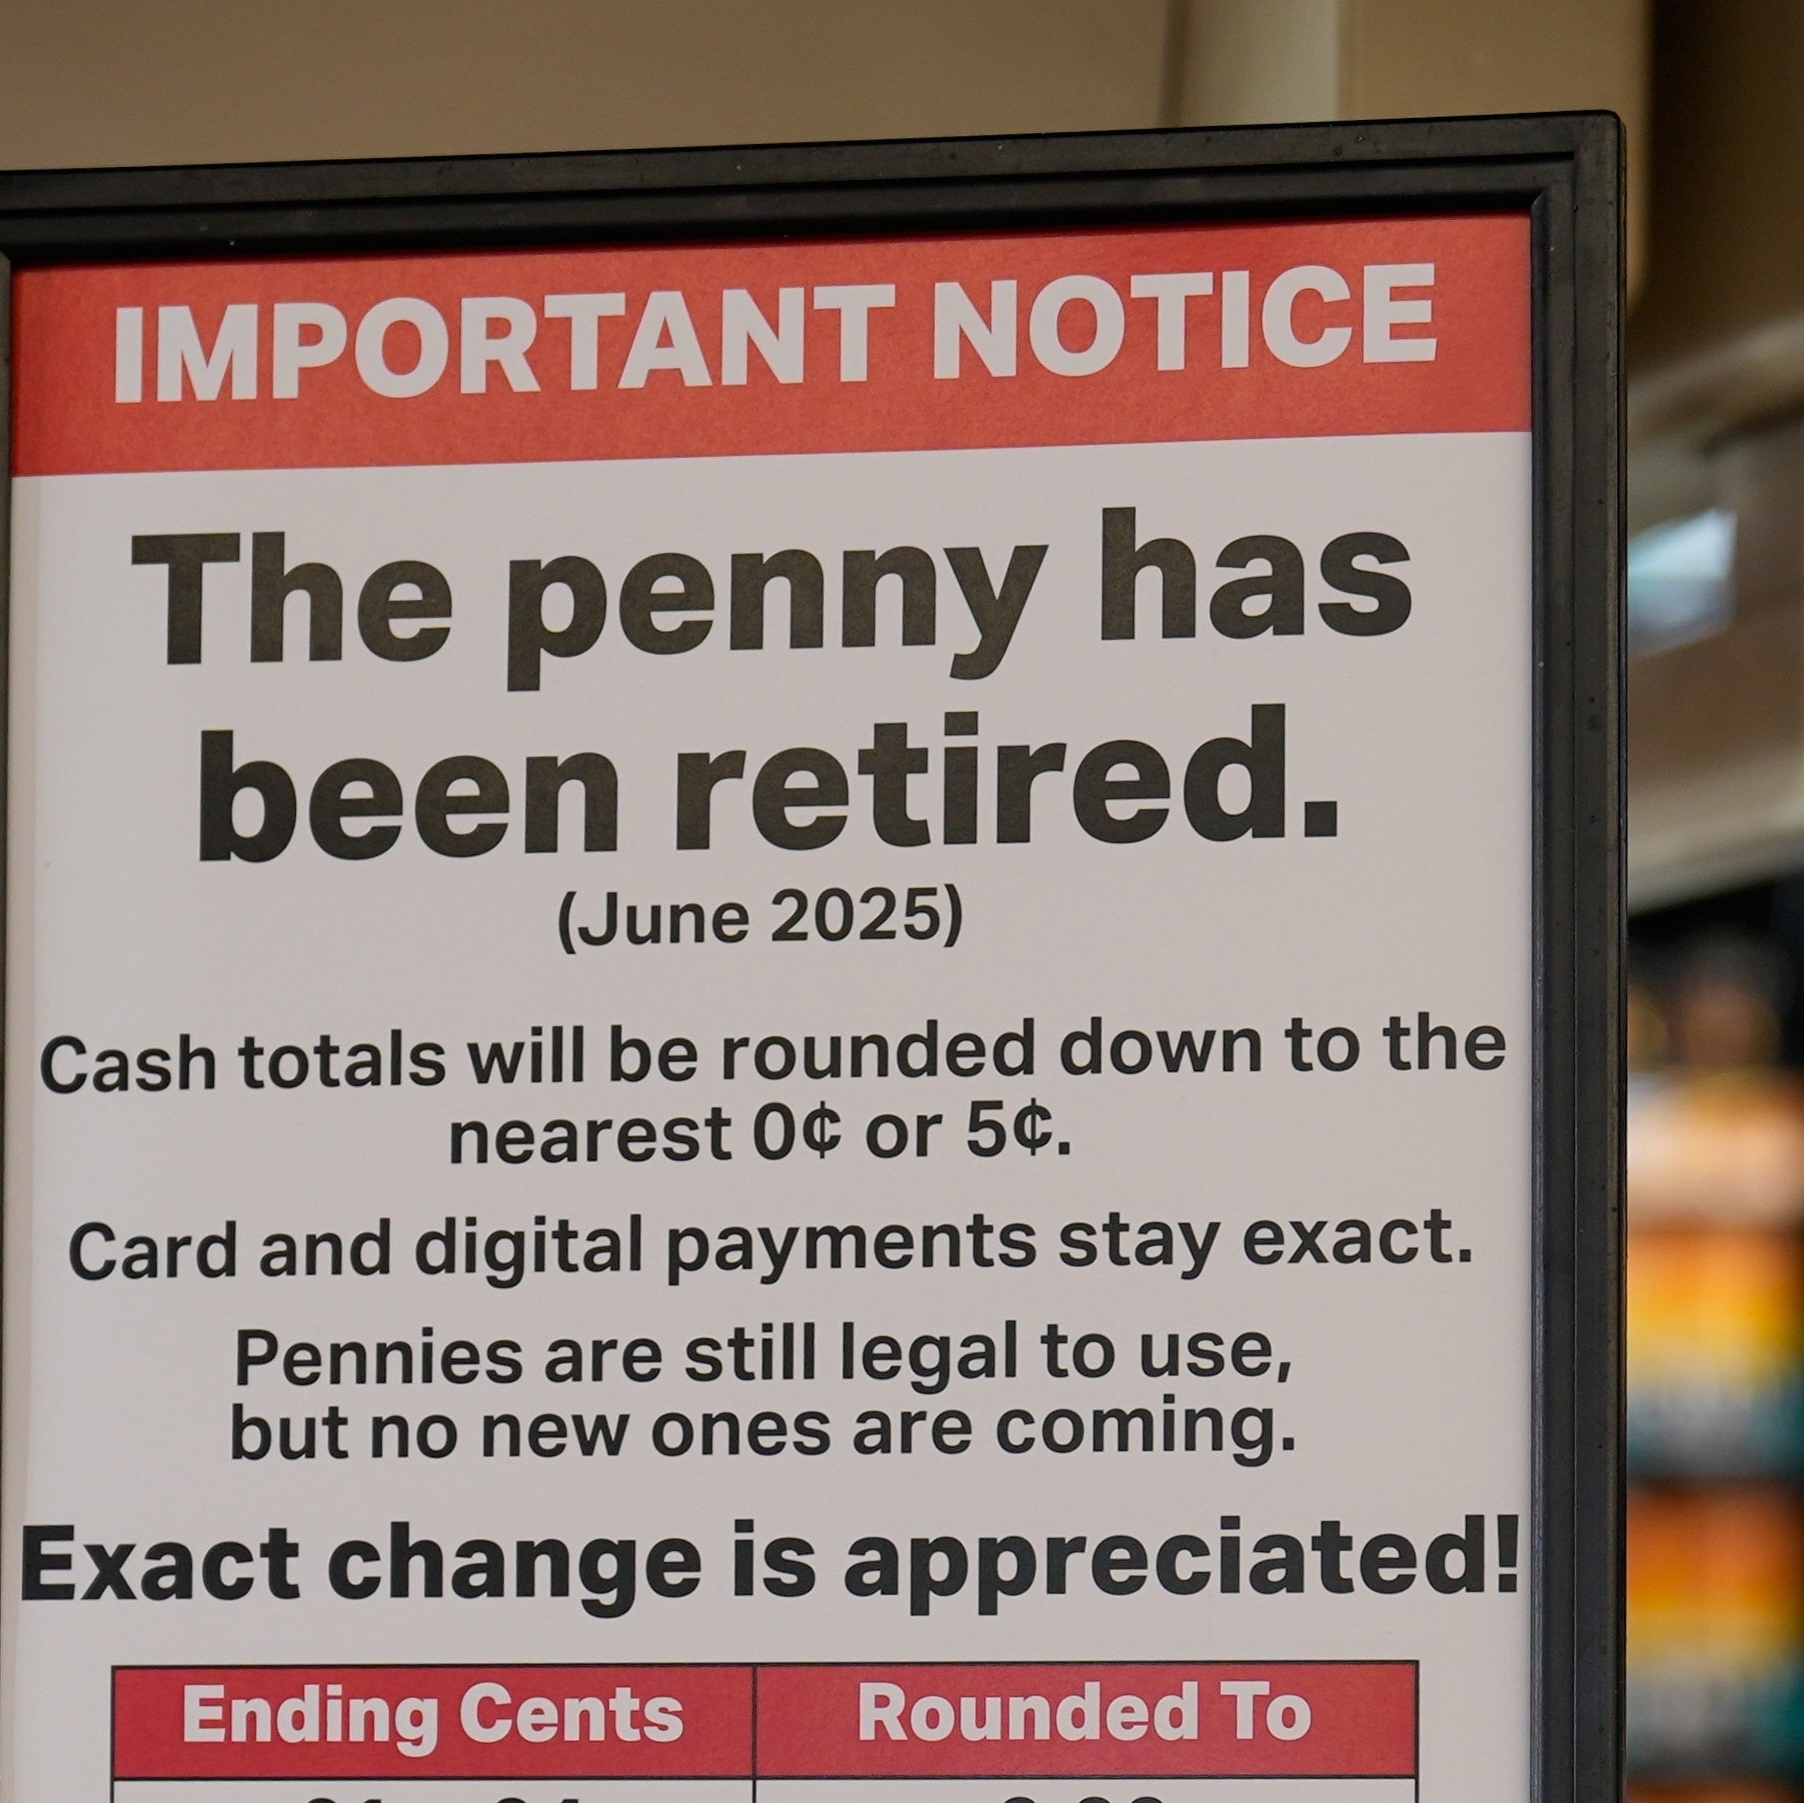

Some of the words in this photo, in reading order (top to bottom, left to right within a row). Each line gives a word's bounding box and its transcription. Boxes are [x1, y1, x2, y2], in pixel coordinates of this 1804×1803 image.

[116, 284, 895, 403] IMPORTANT
[934, 263, 1437, 379] NOTICE
[132, 532, 452, 665] The
[507, 545, 1049, 692] penny
[1101, 507, 1411, 640] has
[200, 730, 618, 863] been
[677, 704, 1337, 851] retired.
[559, 891, 749, 954] (June
[772, 884, 962, 947] 2025)
[41, 1034, 215, 1094] Cash
[238, 1029, 445, 1089] totals
[467, 1025, 583, 1084] will
[611, 1025, 697, 1082] be
[724, 1018, 1034, 1080] rounded
[1061, 1016, 1261, 1075] down
[1285, 1018, 1359, 1072] to
[1383, 1012, 1506, 1070] the
[451, 1107, 732, 1164] nearest
[754, 1101, 841, 1160] 0¢
[866, 1114, 943, 1158] or
[968, 1098, 1070, 1157] 5¢.
[70, 1220, 236, 1281] Card
[260, 1218, 390, 1277] and
[416, 1214, 641, 1289] digital
[668, 1214, 1036, 1286] payments
[1060, 1212, 1221, 1280] stay
[1244, 1209, 1471, 1265] exact.
[237, 1327, 522, 1386] Pennies
[545, 1338, 662, 1383] are
[686, 1322, 815, 1382] still
[843, 1320, 1016, 1395] legal
[1041, 1324, 1115, 1378] to
[1141, 1332, 1290, 1384] use,
[232, 1403, 349, 1460] but
[372, 1415, 457, 1459] no
[483, 1414, 630, 1458] new
[652, 1411, 830, 1457] ones
[854, 1410, 972, 1455] are
[997, 1394, 1294, 1467] coming.
[22, 1525, 300, 1601] Exact
[329, 1521, 701, 1619] change
[734, 1519, 815, 1597] is
[845, 1514, 1519, 1616] appreciated!
[184, 1685, 437, 1757] Ending
[461, 1683, 683, 1742] Cents
[860, 1681, 1198, 1741] Rounded
[1220, 1681, 1311, 1740] To
